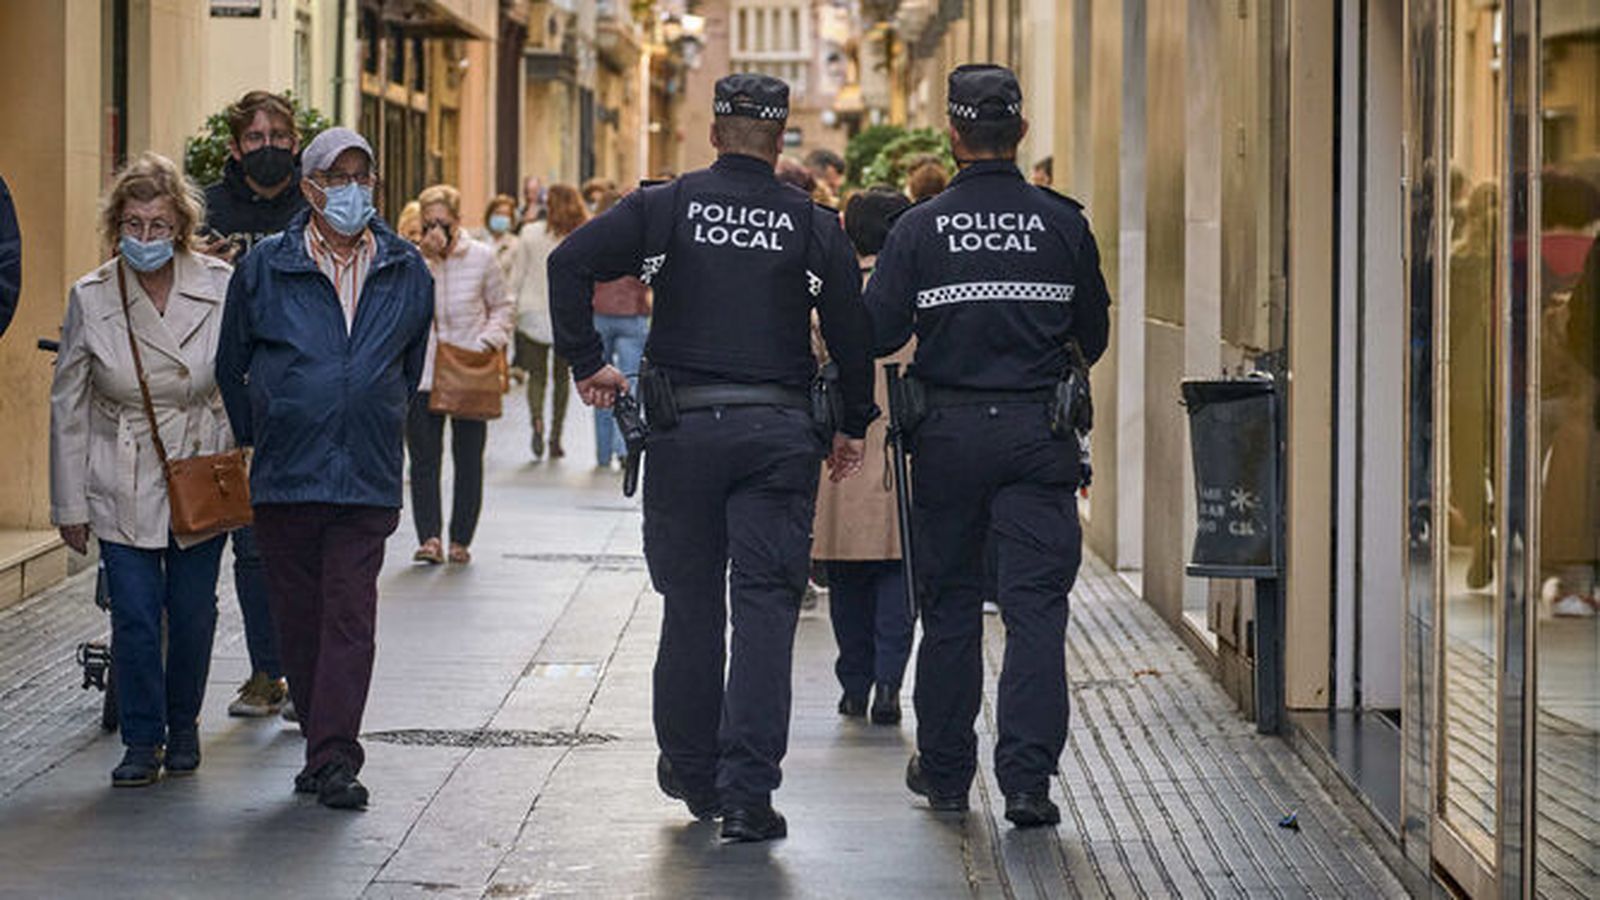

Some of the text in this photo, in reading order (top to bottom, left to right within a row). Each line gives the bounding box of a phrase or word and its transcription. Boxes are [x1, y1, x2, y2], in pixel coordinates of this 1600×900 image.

[687, 202, 794, 231] POLICIA
[936, 212, 1046, 233] POLICIA
[694, 224, 783, 251] LOCAL
[948, 232, 1037, 253] LOCAL
